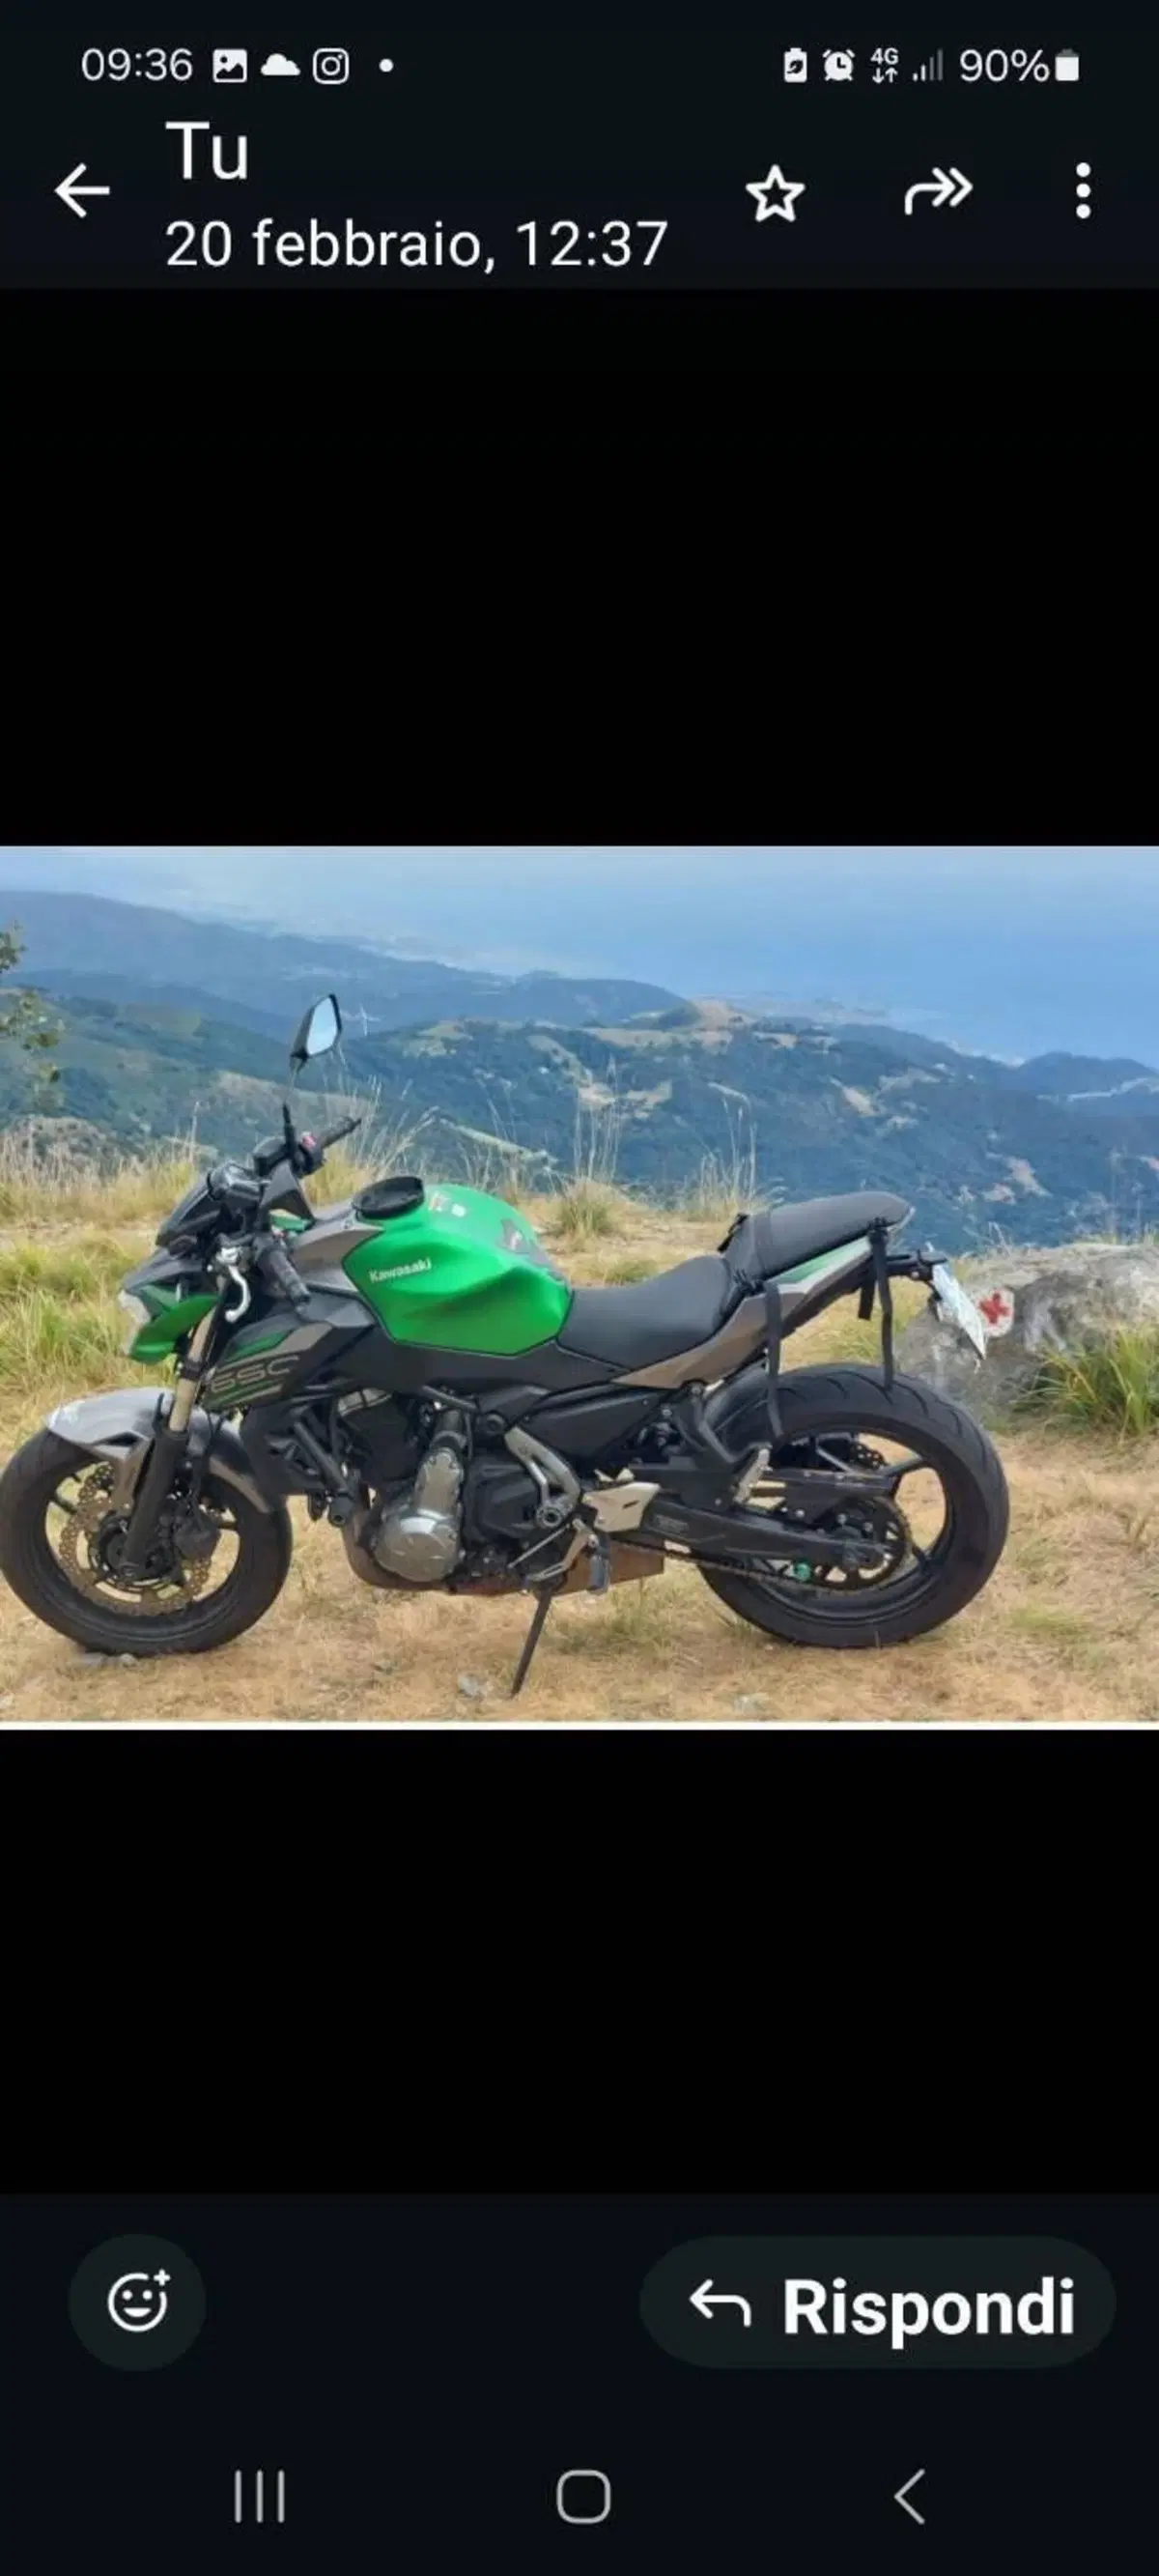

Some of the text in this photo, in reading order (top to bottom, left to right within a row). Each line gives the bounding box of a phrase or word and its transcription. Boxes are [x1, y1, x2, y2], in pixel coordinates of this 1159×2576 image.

[81, 47, 193, 81] 09:36
[870, 47, 899, 65] 4G
[959, 48, 1051, 82] 90%
[165, 121, 247, 180] Tu
[165, 217, 668, 274] 20 febbraio, 12:37
[368, 1257, 432, 1284] Kawasaki
[784, 2275, 1074, 2350] Rispondi
